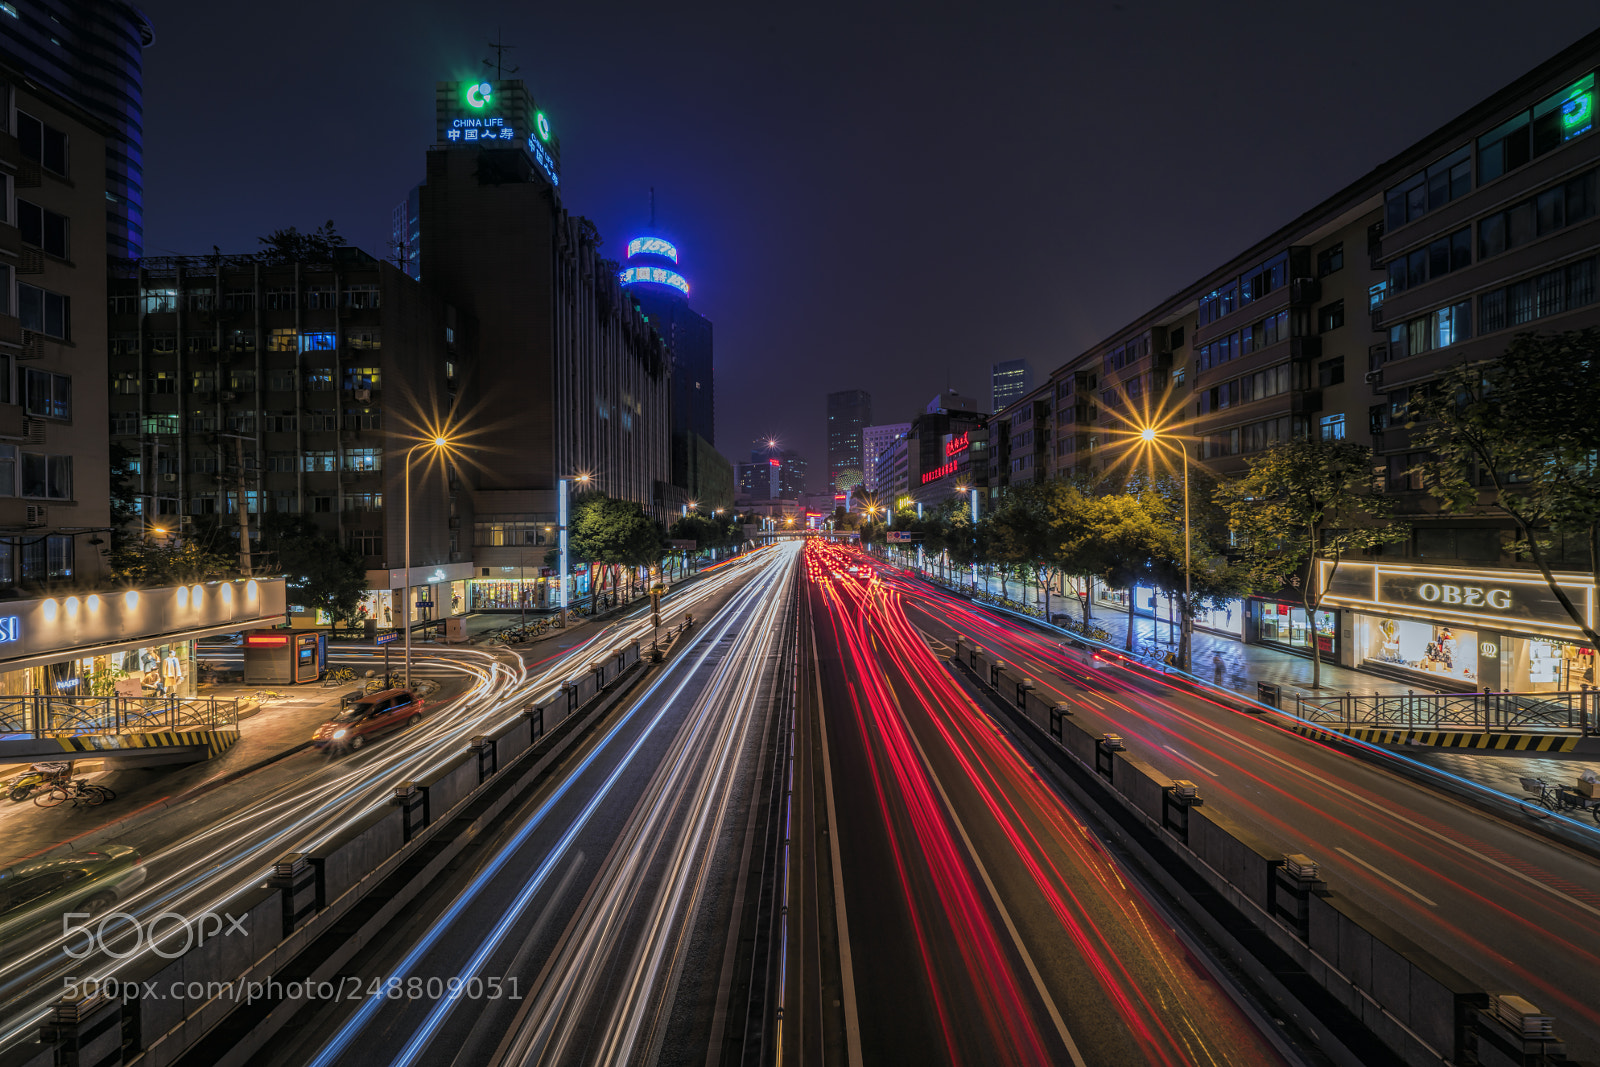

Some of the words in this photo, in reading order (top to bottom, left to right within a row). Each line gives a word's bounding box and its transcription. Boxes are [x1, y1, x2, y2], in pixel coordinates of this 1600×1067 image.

[453, 119, 482, 128] CHINA
[484, 118, 503, 127] LIFE
[448, 128, 513, 141] 中国人寿
[1419, 583, 1512, 609] OBEG
